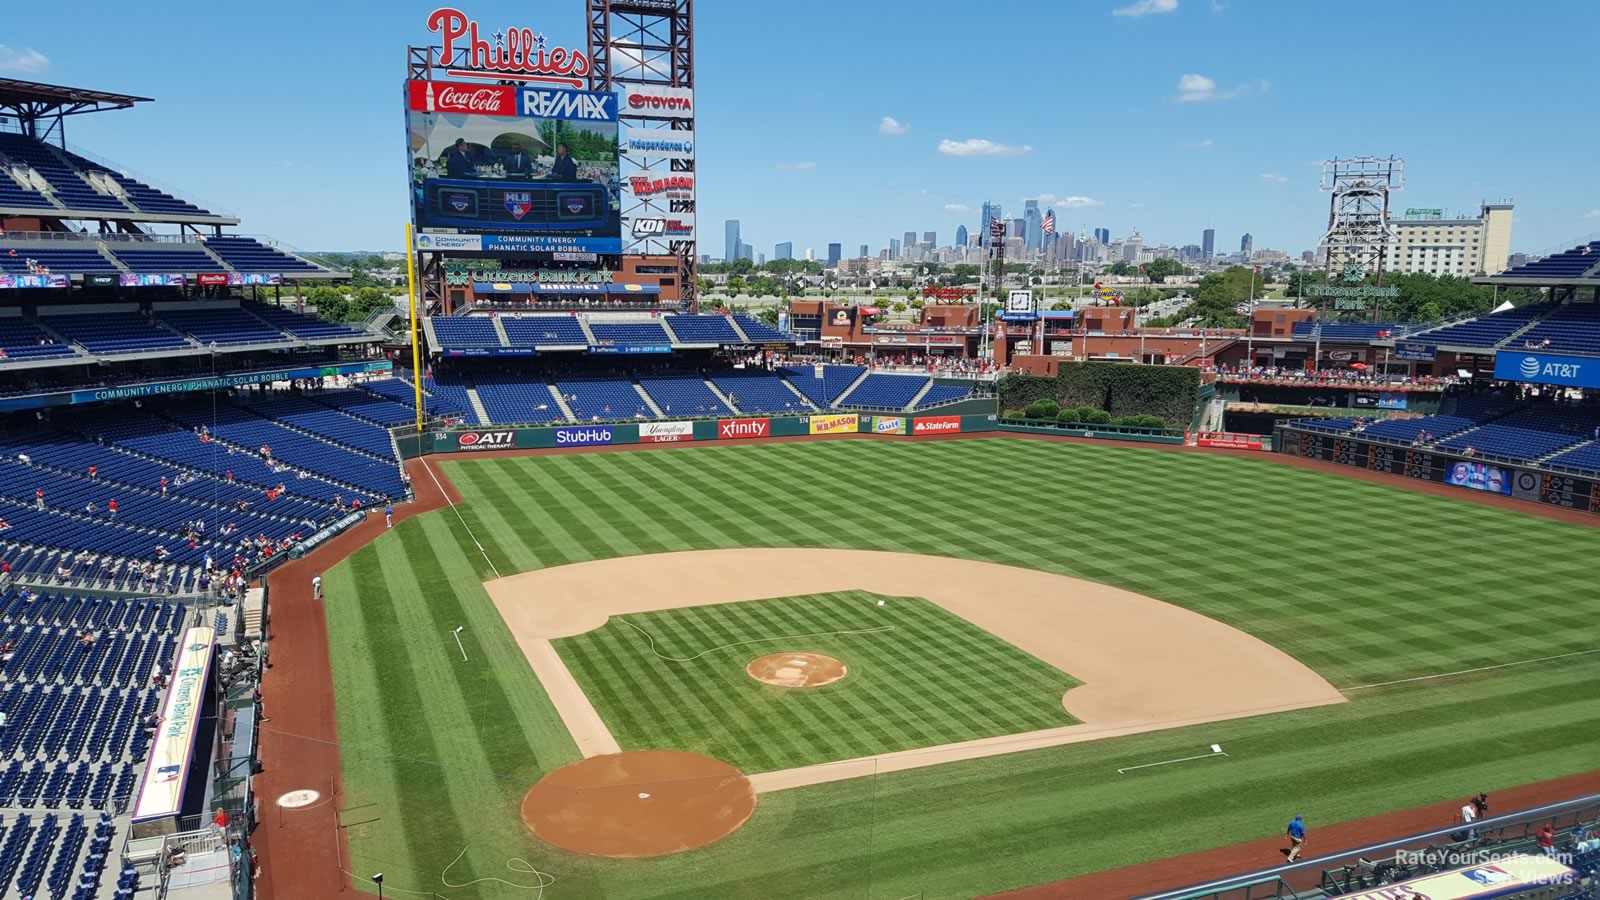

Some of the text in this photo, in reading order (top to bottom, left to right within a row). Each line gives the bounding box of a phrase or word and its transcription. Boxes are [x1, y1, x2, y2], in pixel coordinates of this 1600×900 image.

[427, 8, 589, 77] Phillies
[439, 86, 503, 111] Coca-Cola
[523, 90, 609, 119] RE/MAX
[644, 96, 691, 110] TOYOTA
[629, 139, 682, 152] Independence
[506, 193, 529, 201] MLB
[633, 218, 666, 233] KDI
[498, 235, 577, 244] COMMUNITY ENERGY
[489, 244, 528, 252] PHANATIC
[472, 267, 613, 283] Citizens Bank Park
[1306, 284, 1400, 297] Citizens Bank
[1335, 298, 1365, 310] Park
[1542, 363, 1581, 378] AT&T
[95, 373, 289, 400] COMMUNITY ENERGY PHANATIC SOLAR BOBBLE
[646, 423, 687, 435] Yuengling
[722, 421, 766, 437] xfinity
[878, 421, 899, 431] Gulf
[477, 432, 513, 444] ATI
[556, 429, 611, 443] StubHub
[166, 677, 197, 738] Citizens Bank Park
